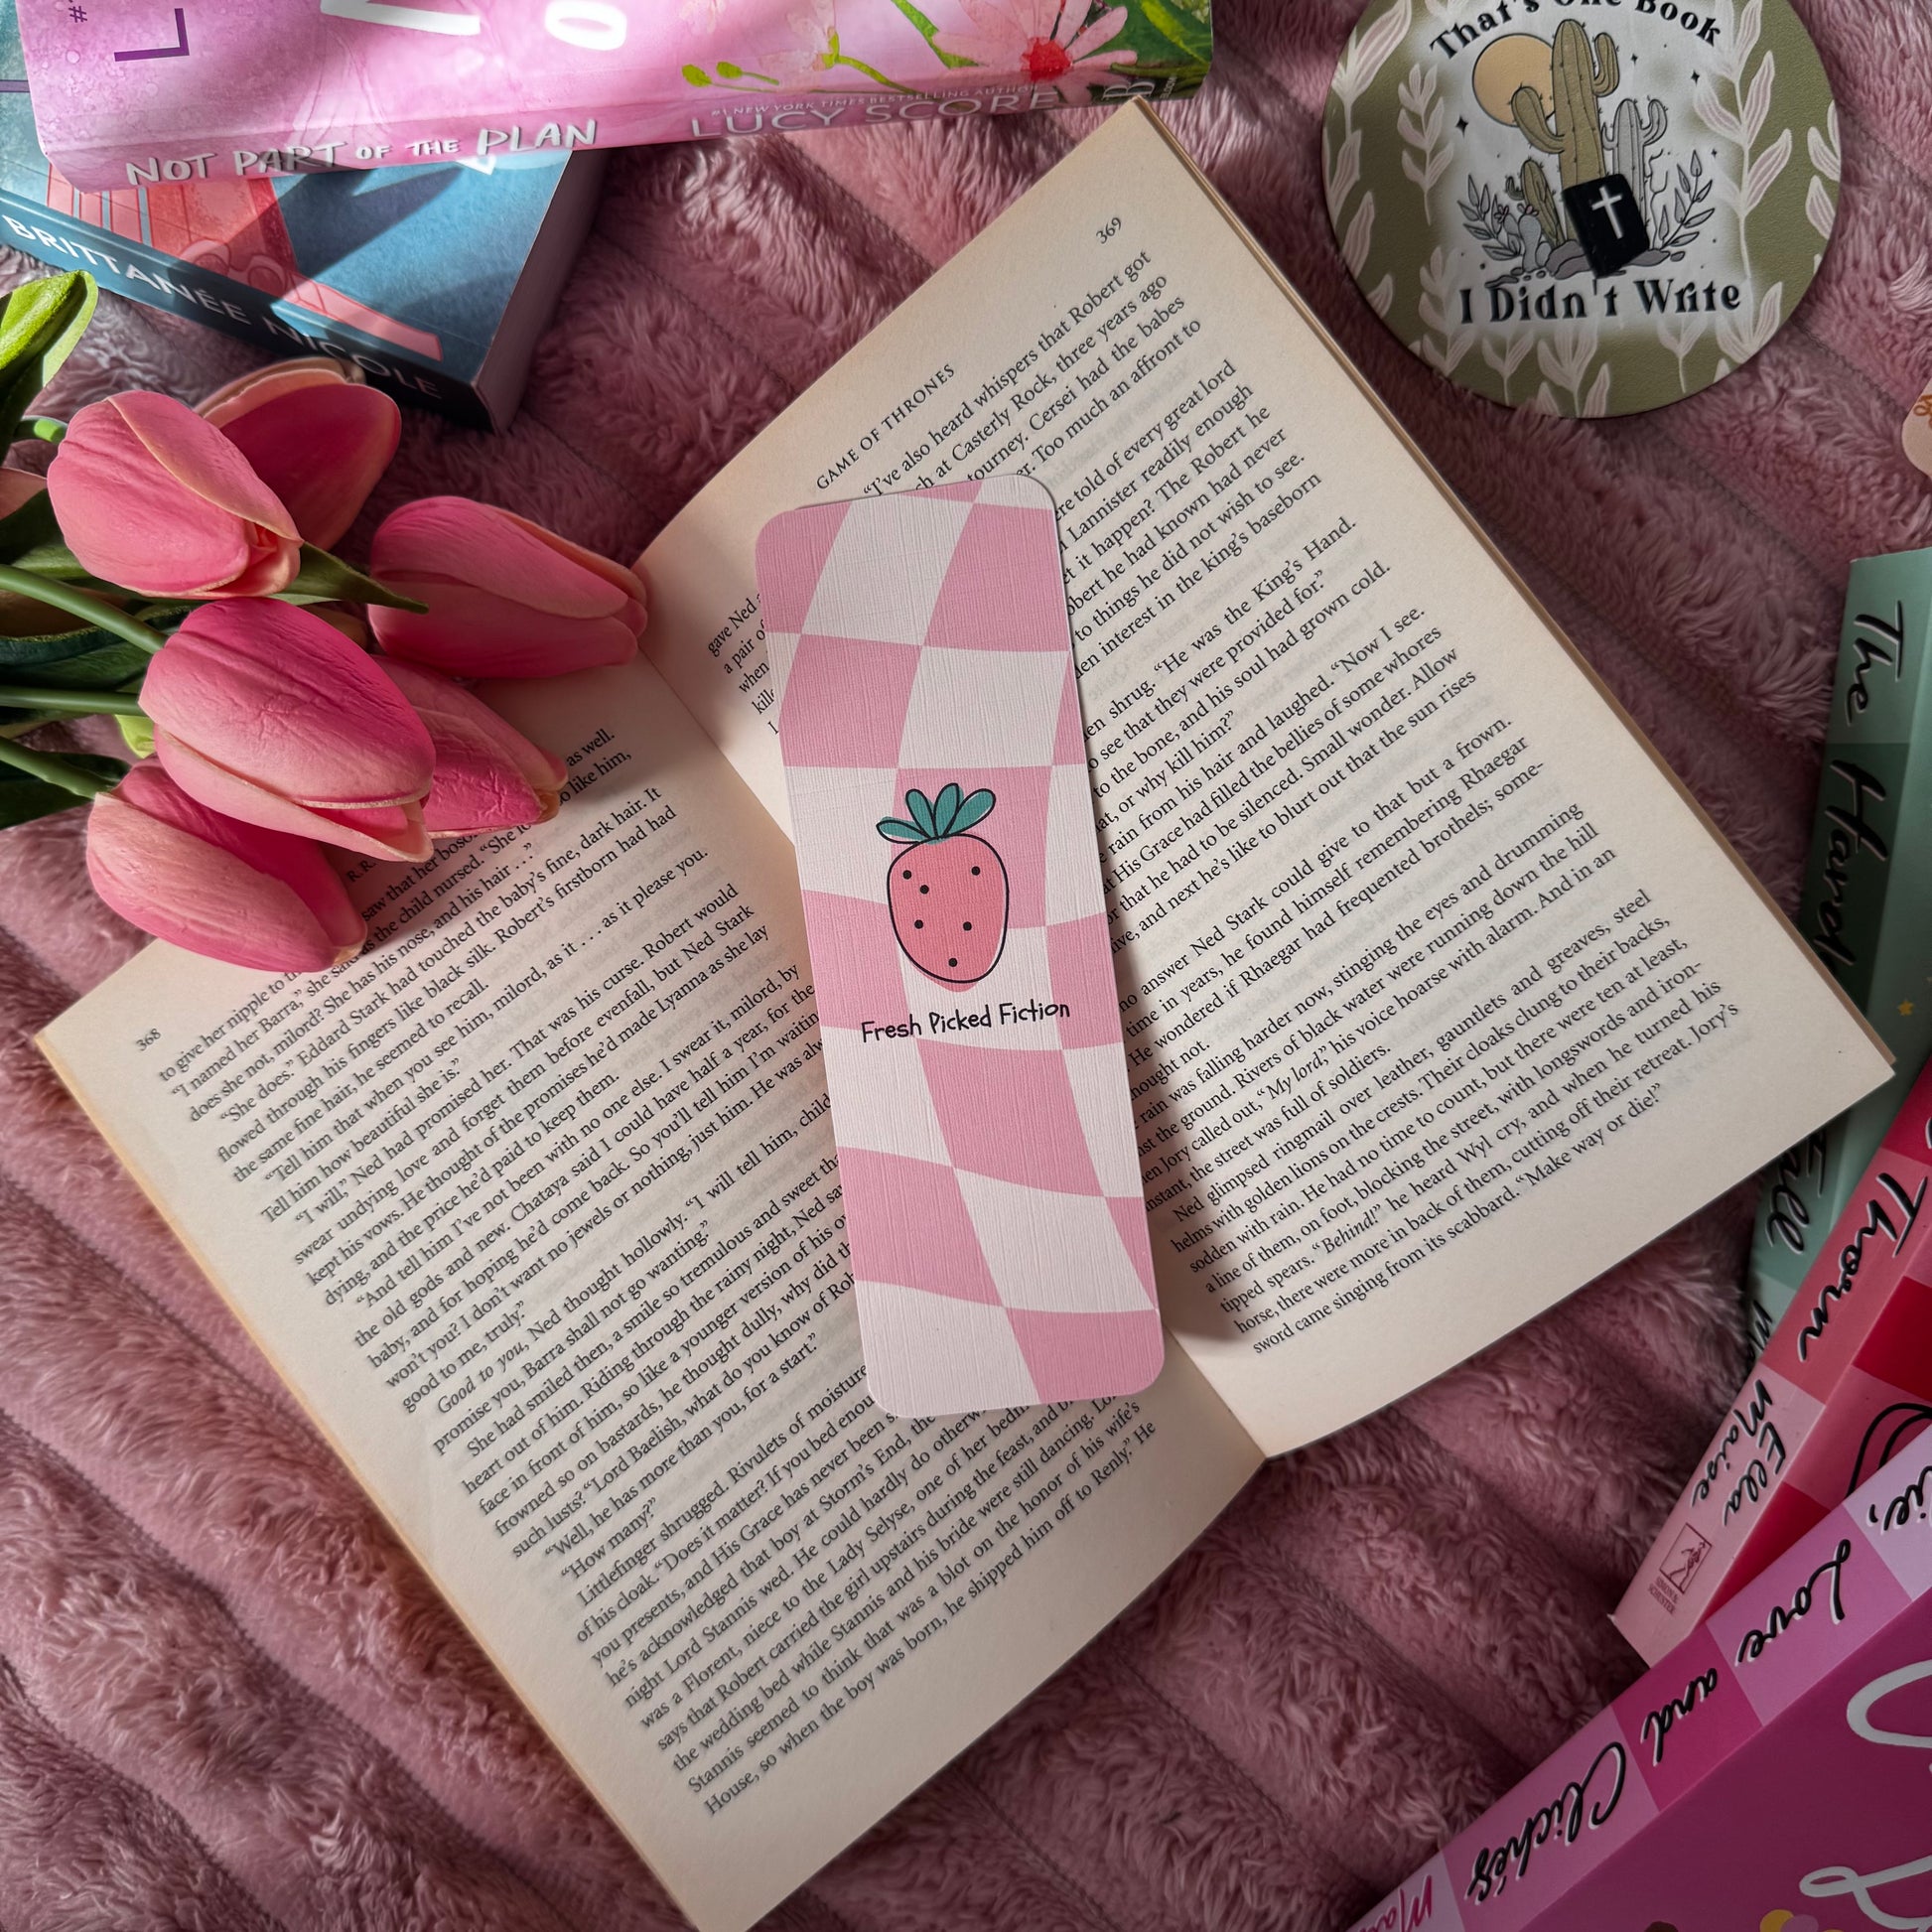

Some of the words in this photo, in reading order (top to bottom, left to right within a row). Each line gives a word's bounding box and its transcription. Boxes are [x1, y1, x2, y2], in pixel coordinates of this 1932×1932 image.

[126, 152, 215, 186] NOT
[233, 141, 347, 177] PART
[355, 144, 392, 161] OF
[407, 138, 461, 157] THE
[475, 119, 598, 157] PLAN
[691, 108, 845, 137] LUCY
[866, 90, 1059, 123] SCORE
[734, 104, 769, 115] NEW
[773, 100, 814, 111] YORK
[821, 97, 865, 108] TIMES
[981, 83, 1038, 95] AUTHOR
[1095, 216, 1122, 244] 369
[2, 213, 252, 326] BRITTANÉE
[264, 316, 442, 398] NICOLE
[900, 443, 931, 473] also
[927, 400, 975, 447] heard
[972, 348, 1038, 407] whispers
[1036, 320, 1071, 352] that
[1066, 274, 1124, 326] Robert
[1123, 250, 1152, 283] got
[1459, 289, 1473, 325] I
[1633, 279, 1741, 315] Write
[816, 448, 860, 489] GAME
[859, 427, 880, 451] OF
[880, 362, 955, 430] THRONES
[708, 625, 733, 657] gave
[729, 598, 757, 629] Ned
[724, 662, 733, 674] a
[732, 639, 755, 669] pair
[739, 661, 769, 693] when
[1093, 781, 1111, 799] to
[1110, 760, 1137, 784] the
[1132, 731, 1180, 764] bone,
[1178, 699, 1210, 732] and
[1204, 684, 1234, 709] his
[1233, 653, 1269, 689] soul
[1263, 628, 1300, 662] had
[1299, 593, 1351, 640] grown
[1350, 559, 1391, 596] cold.
[1099, 737, 1125, 760] see
[1122, 711, 1157, 741] that
[1154, 684, 1188, 716] they
[1187, 655, 1226, 687] were
[1224, 597, 1296, 664] provided
[1293, 569, 1324, 606] for.”
[1846, 600, 1903, 727] The
[565, 751, 584, 767] as
[580, 727, 616, 755] well.
[135, 1028, 161, 1051] 368
[232, 1160, 258, 1182] the
[258, 1131, 295, 1164] same
[293, 1108, 324, 1135] fine
[320, 1083, 358, 1112] hair,
[351, 1066, 376, 1086] he
[375, 1022, 430, 1070] seemed
[427, 1013, 446, 1029] to
[444, 977, 489, 1016] recall.
[860, 1014, 922, 1043] Fresh
[928, 1003, 992, 1035] Picked
[999, 998, 1070, 1026] Fiction
[259, 1194, 291, 1222] Tell
[287, 1174, 322, 1202] him
[317, 1148, 351, 1178] how
[348, 1095, 417, 1153] beautiful
[416, 1079, 443, 1103] she
[441, 1056, 461, 1084] is.”
[325, 1269, 371, 1306] dying,
[369, 1239, 399, 1271] and
[396, 1224, 424, 1247] the
[422, 1194, 461, 1232] price
[456, 1166, 493, 1199] he’d
[490, 1140, 526, 1177] paid
[523, 1131, 542, 1147] to
[537, 1103, 577, 1135] keep
[575, 1073, 620, 1107] them.
[1233, 1308, 1280, 1334] horse,
[1276, 1284, 1314, 1311] there
[1312, 1263, 1350, 1289] were
[1348, 1238, 1390, 1269] more
[1386, 1227, 1409, 1243] in
[1403, 1200, 1448, 1231] back
[1445, 1183, 1464, 1206] of
[1462, 1163, 1513, 1194] them,
[1511, 1120, 1571, 1164] cutting
[1568, 1097, 1593, 1125] off
[1591, 1075, 1633, 1108] their
[1631, 1037, 1693, 1081] retreat.
[1687, 1003, 1738, 1043] Jory’s
[1252, 1321, 1296, 1354] sword
[1294, 1304, 1332, 1331] came
[1331, 1271, 1389, 1310] singing
[1384, 1248, 1427, 1277] from
[1422, 1234, 1447, 1253] its
[1446, 1184, 1521, 1239] scabbard.
[1514, 1151, 1573, 1186] “Make
[1570, 1128, 1604, 1155] way
[1605, 1114, 1626, 1133] or
[1627, 1082, 1661, 1118] die!”
[1798, 1173, 1928, 1361] Thorn
[544, 1522, 595, 1556] “Well,
[588, 1507, 613, 1528] he
[608, 1485, 639, 1512] has
[637, 1453, 679, 1490] more
[676, 1426, 714, 1457] than
[711, 1402, 748, 1434] you,
[743, 1379, 767, 1404] for
[767, 1371, 780, 1384] a
[778, 1331, 817, 1375] start.”
[1692, 1379, 1773, 1507] Maise
[1723, 1422, 1786, 1526] Ella
[560, 1544, 607, 1580] “How
[607, 1496, 656, 1550] many?”
[576, 1537, 657, 1606] Littlefinger
[659, 1479, 730, 1542] shrugged.
[726, 1432, 788, 1485] Rivulets
[787, 1411, 806, 1436] of
[703, 1772, 759, 1816] House,
[759, 1753, 777, 1772] so
[777, 1720, 820, 1754] when
[819, 1697, 846, 1722] the
[842, 1671, 876, 1700] boy
[876, 1647, 905, 1674] was
[901, 1616, 948, 1650] born,
[942, 1595, 967, 1617] he
[967, 1542, 1024, 1599] shipped
[1019, 1519, 1054, 1550] him
[1054, 1492, 1075, 1521] off
[1074, 1484, 1092, 1501] to
[1089, 1437, 1133, 1486] Renly.”
[1132, 1422, 1156, 1446] He
[1735, 1539, 1851, 1666] Love
[1641, 1668, 1719, 1765] and
[1464, 1740, 1626, 1905] Clichés
